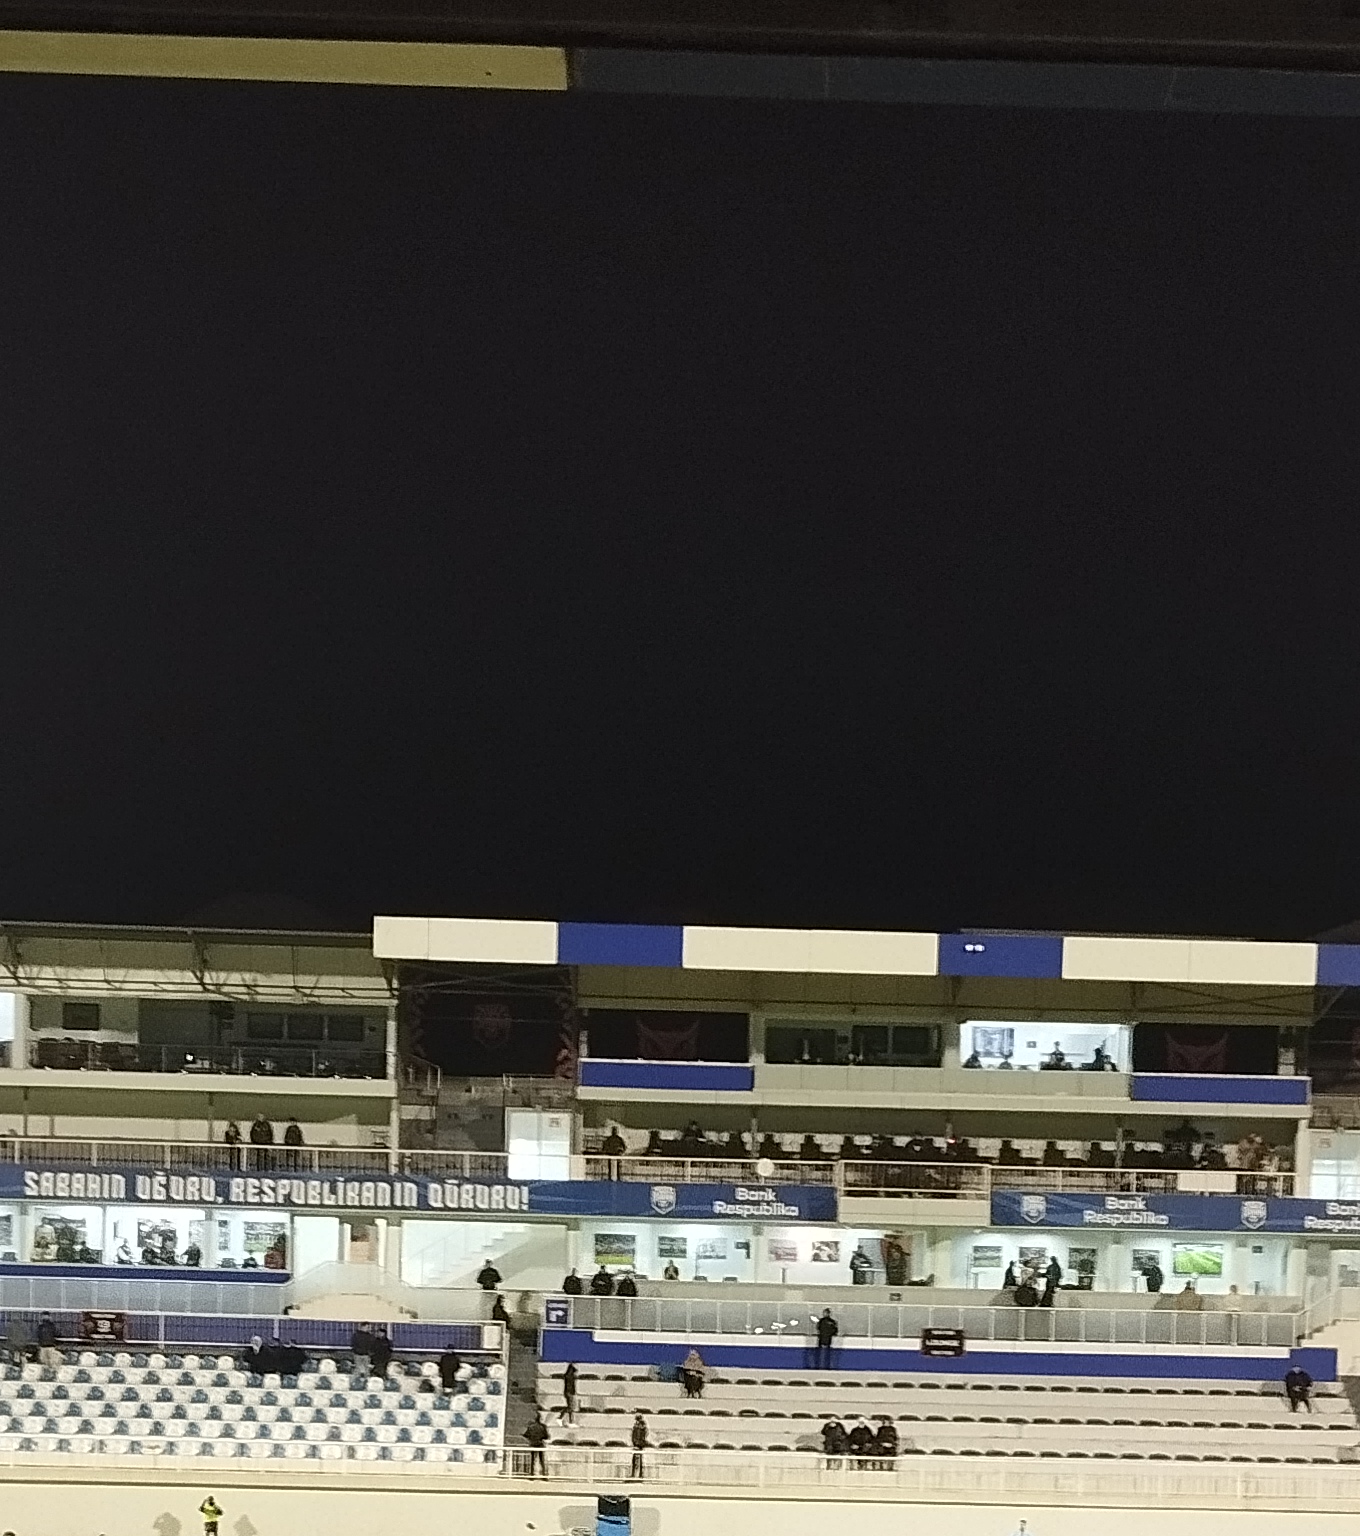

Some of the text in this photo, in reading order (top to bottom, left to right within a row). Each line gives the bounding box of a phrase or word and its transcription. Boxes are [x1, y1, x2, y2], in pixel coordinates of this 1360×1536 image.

[24, 1171, 126, 1199] SABAHIN
[135, 1170, 223, 1204] UĞURU,
[734, 1187, 776, 1202] Bank
[713, 1200, 799, 1217] Respublika
[1105, 1196, 1147, 1210] Bank
[1082, 1209, 1170, 1226] Respublika
